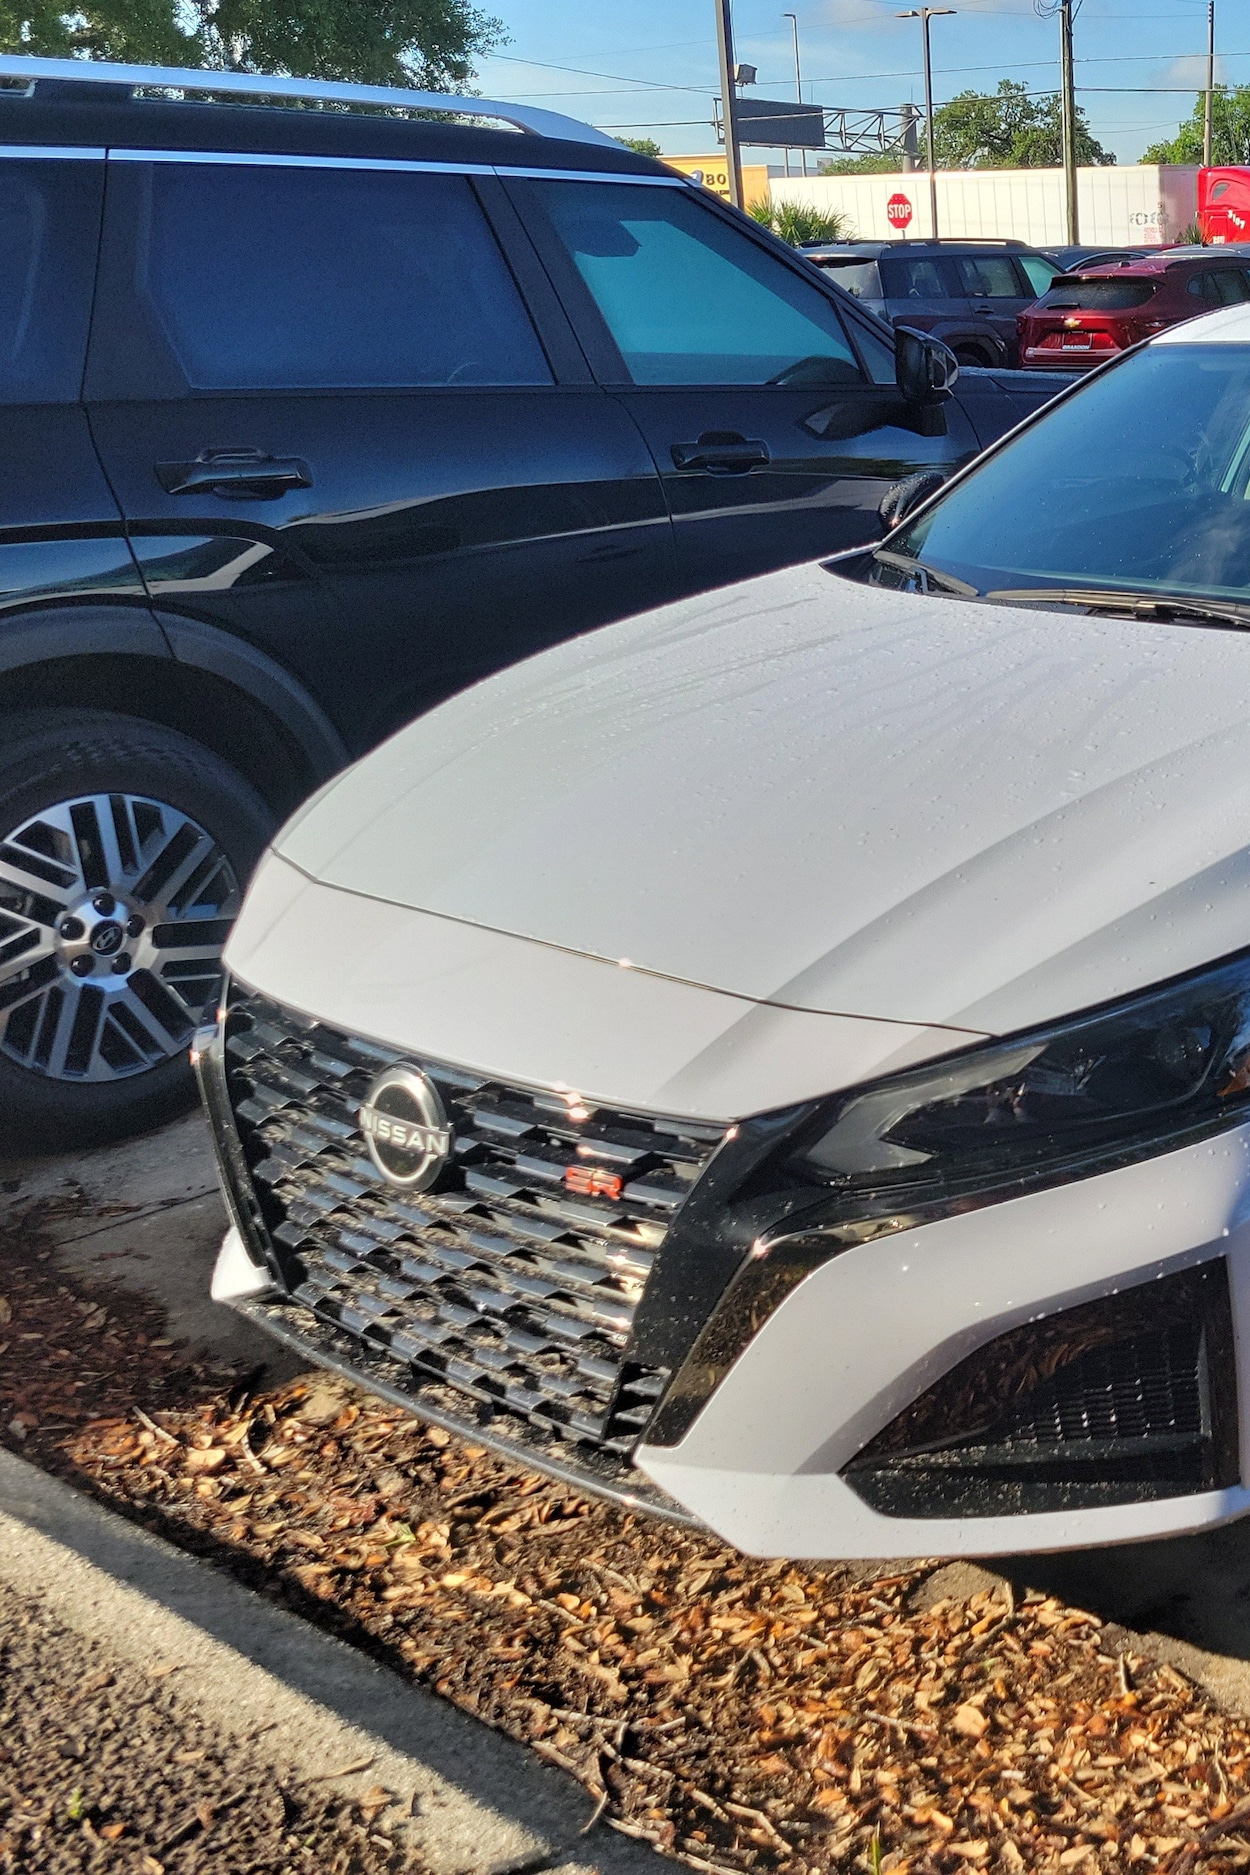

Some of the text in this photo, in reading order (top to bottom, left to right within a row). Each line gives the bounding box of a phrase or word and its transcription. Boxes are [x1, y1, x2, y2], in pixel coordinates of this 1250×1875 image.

[706, 173, 728, 185] BO
[888, 204, 911, 219] STOP
[360, 1106, 447, 1155] NISSAN
[565, 1165, 623, 1202] SR
